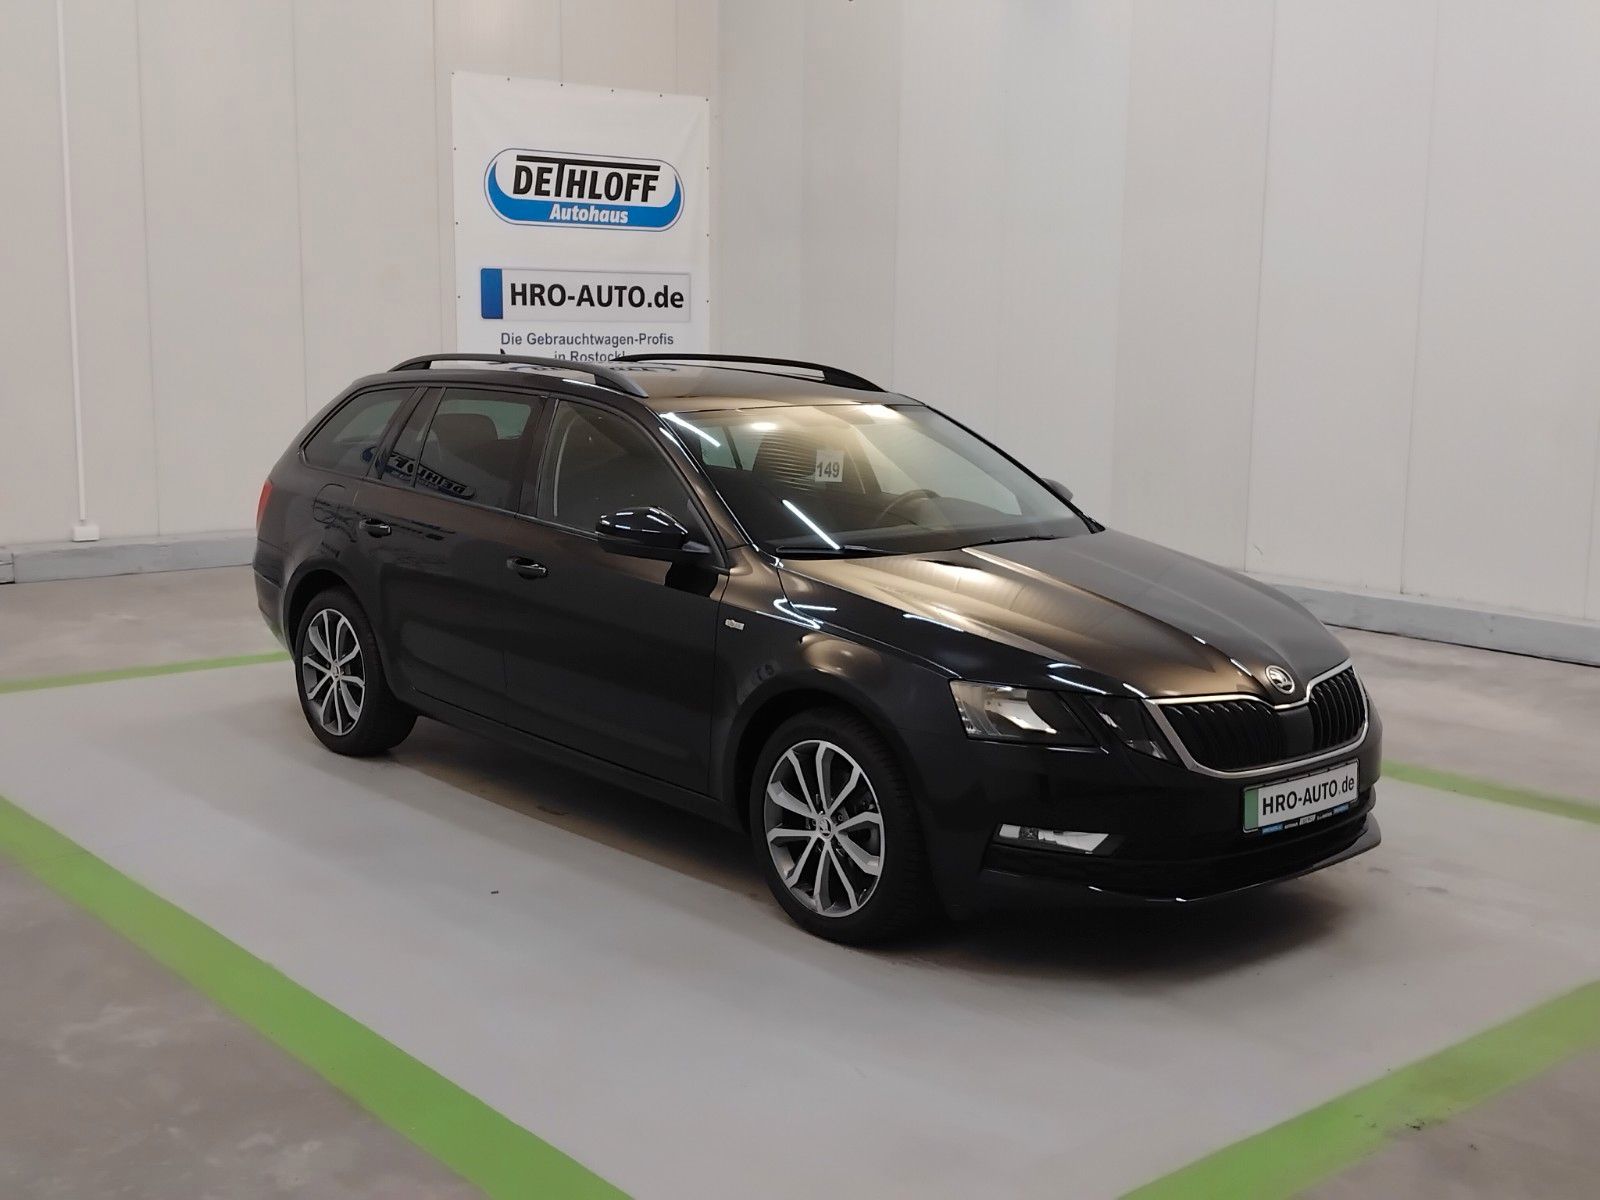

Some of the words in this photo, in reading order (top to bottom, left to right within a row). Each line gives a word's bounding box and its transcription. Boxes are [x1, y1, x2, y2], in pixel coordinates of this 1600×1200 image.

[512, 154, 661, 203] DETHLOFF
[549, 203, 629, 224] Autohaus
[510, 283, 684, 309] HRO-AUTO.de
[501, 332, 521, 345] Die
[526, 332, 674, 348] Gebrauchtwagen-Profis
[554, 351, 566, 360] in
[816, 462, 840, 478] 149
[1262, 775, 1355, 816] HRO-AUTO.de
